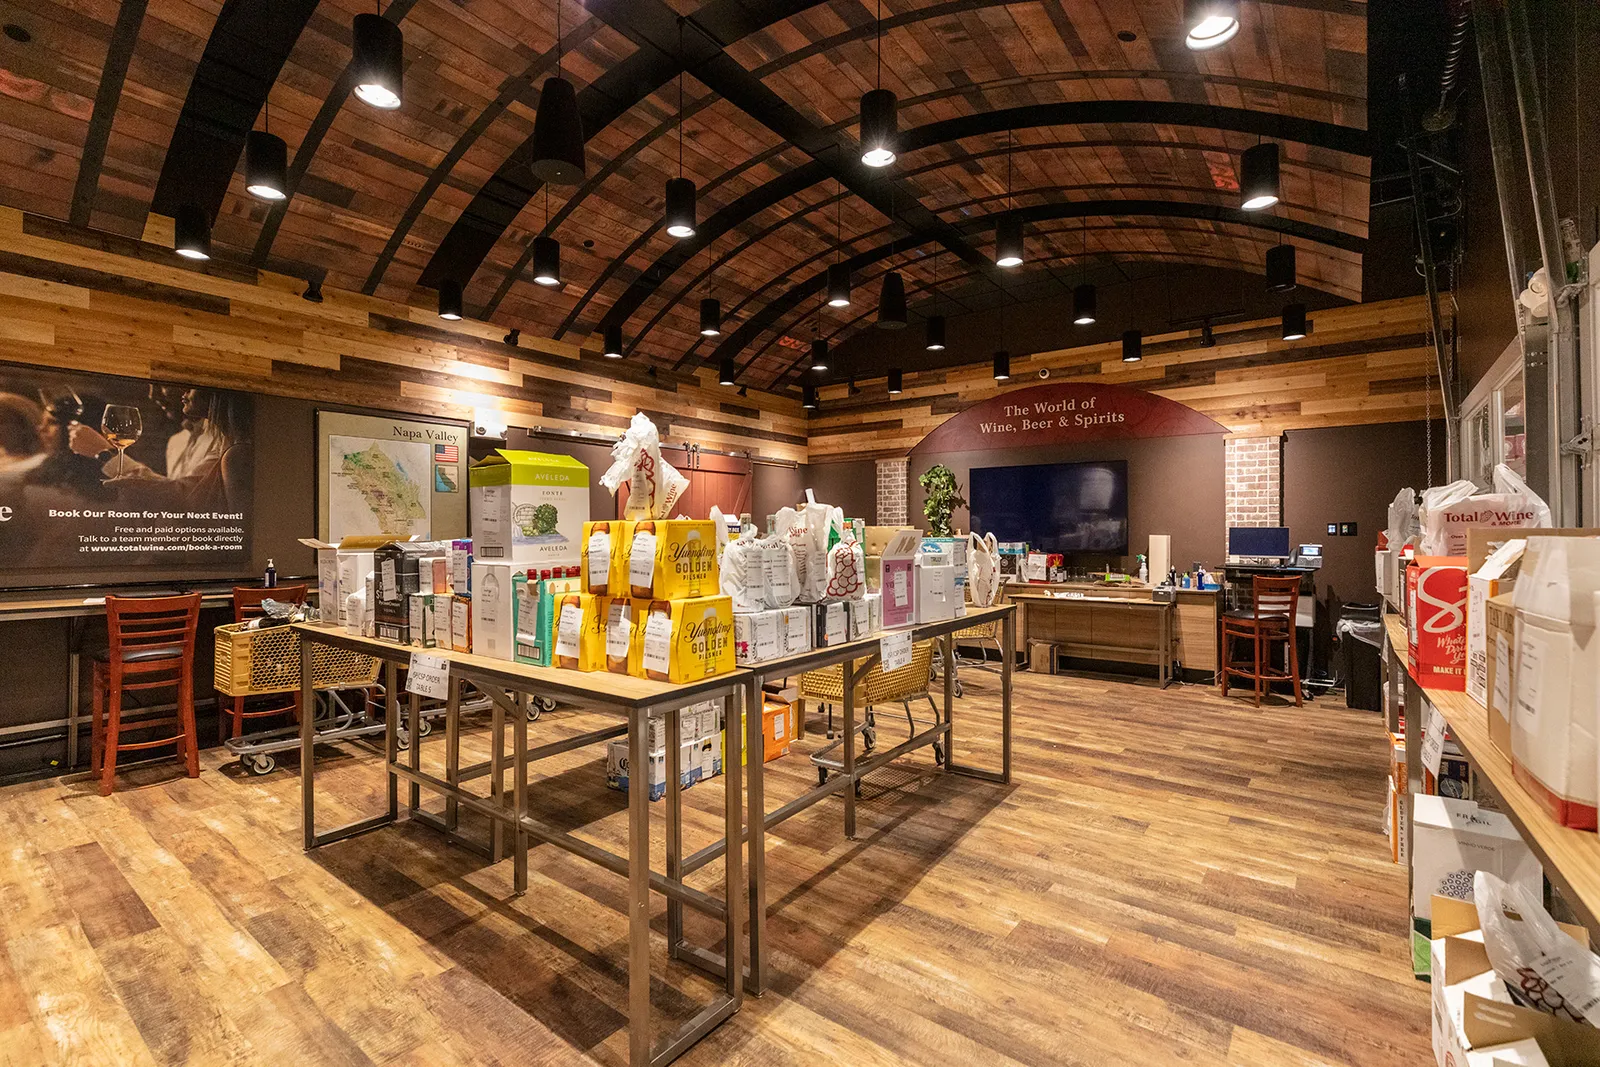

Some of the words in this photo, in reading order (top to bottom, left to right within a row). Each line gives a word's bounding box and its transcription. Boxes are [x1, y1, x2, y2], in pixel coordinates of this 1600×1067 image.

[1004, 406, 1029, 417] The
[1034, 400, 1075, 414] World
[1081, 396, 1096, 410] of
[980, 422, 1017, 434] Wine,
[1022, 419, 1053, 431] Beer
[1058, 416, 1070, 428] &
[1074, 412, 1125, 429] Spirits
[393, 426, 422, 440] Napa
[425, 429, 459, 444] Valley
[48, 509, 81, 518] Book
[83, 510, 106, 518] Our
[108, 510, 141, 519] Room
[142, 510, 159, 519] for
[187, 512, 210, 520] Next
[212, 512, 243, 520] Event!
[1444, 512, 1478, 523] Total
[1495, 510, 1534, 521] Wine
[154, 526, 174, 534] paid
[175, 526, 206, 534] options
[207, 526, 244, 534] available.
[78, 535, 98, 543] Talk
[91, 544, 242, 552] www.totalwine.com/book-a-room
[668, 542, 716, 562] Yuengling
[675, 560, 713, 574] GOLDEN
[684, 620, 732, 643] Yuengling
[691, 637, 728, 654] GOLDEN
[699, 650, 722, 660] PILSNER
[1433, 666, 1453, 674] MAKE
